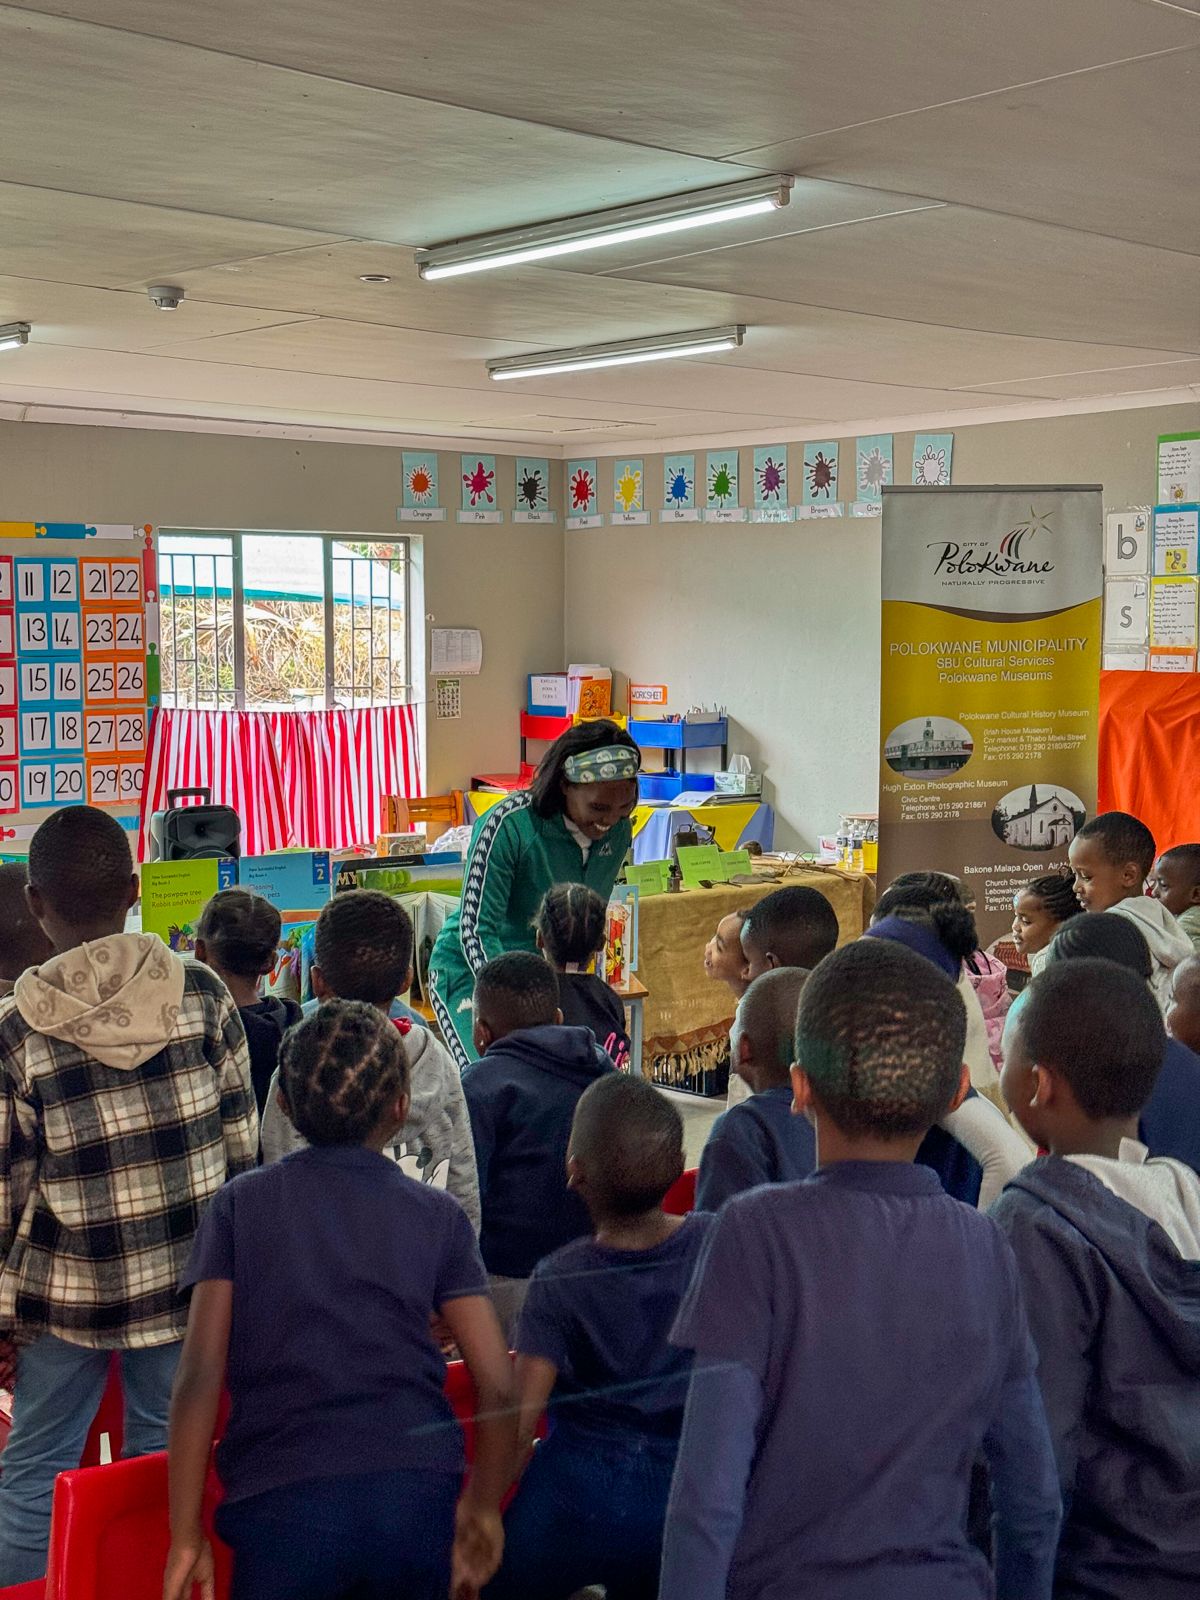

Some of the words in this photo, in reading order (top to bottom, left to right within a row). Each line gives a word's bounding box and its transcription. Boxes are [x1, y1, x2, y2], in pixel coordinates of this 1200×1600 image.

[412, 510, 432, 519] Orange
[866, 504, 882, 513] Grey
[763, 511, 780, 520] Purple
[1118, 524, 1138, 560] b
[24, 572, 34, 596] 11
[53, 570, 72, 594] 12
[90, 569, 106, 592] 21
[112, 569, 139, 592] 22
[1120, 606, 1132, 628] s
[26, 617, 46, 642] 13
[55, 618, 73, 646] 14
[86, 619, 113, 642] 23
[116, 618, 142, 644] 24
[890, 640, 982, 656] POLOKWANE
[986, 638, 1087, 653] MUNICIPALITY
[936, 658, 960, 669] SBU
[964, 656, 1005, 668] Cultural
[1009, 656, 1054, 667] Services
[30, 668, 47, 692] 15
[60, 668, 76, 692] 16
[88, 668, 114, 692] 25
[118, 667, 143, 690] 26
[939, 672, 997, 683] Polokwane
[1001, 671, 1052, 681] Museums
[632, 691, 662, 700] WORKSHEET
[1031, 711, 1056, 719] History
[30, 717, 48, 741] 17
[61, 716, 77, 740] 18
[89, 720, 114, 744] 27
[120, 718, 143, 742] 28
[0, 778, 12, 801] 0
[29, 772, 46, 796] 19
[55, 770, 82, 794] 20
[92, 770, 118, 794] 29
[120, 768, 144, 792] 30
[882, 784, 901, 793] Hugh
[927, 781, 975, 790] Photographic
[317, 868, 324, 880] 2
[964, 866, 992, 874] Bakone
[994, 865, 1021, 873] Malapa
[1022, 863, 1043, 871] Open
[222, 876, 230, 888] 2
[336, 872, 357, 886] MY
